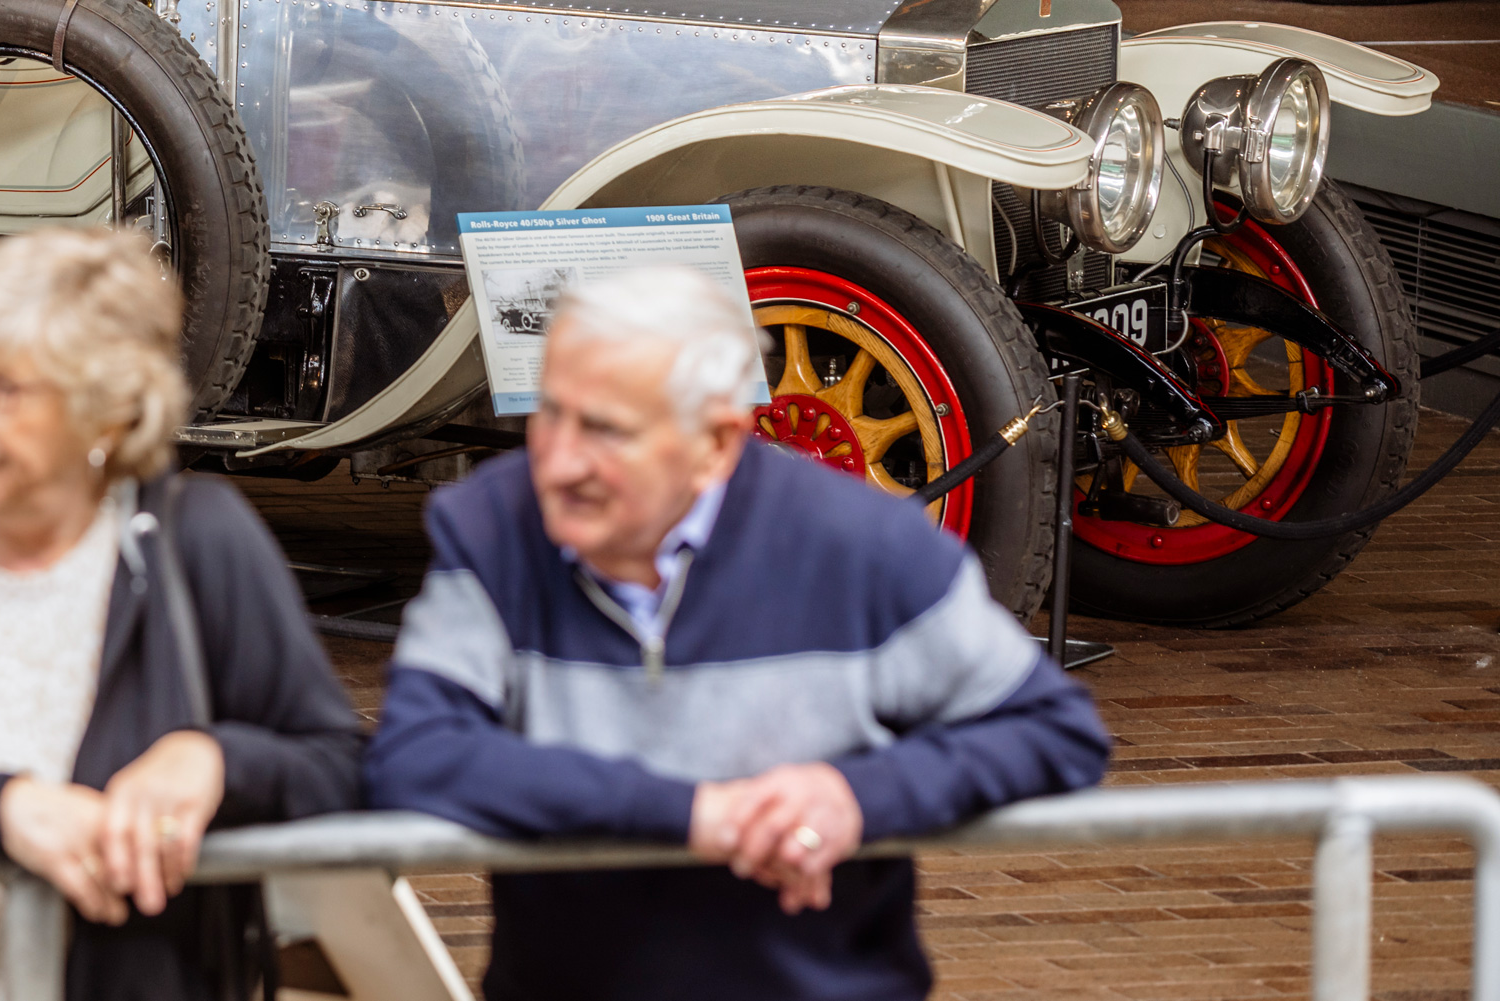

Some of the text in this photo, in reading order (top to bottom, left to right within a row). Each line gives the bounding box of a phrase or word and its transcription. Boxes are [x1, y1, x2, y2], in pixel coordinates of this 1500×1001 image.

[470, 216, 607, 230] Rolls-Royce 40/50hp Silver Ghost
[646, 212, 720, 222] 1909 Great Britain
